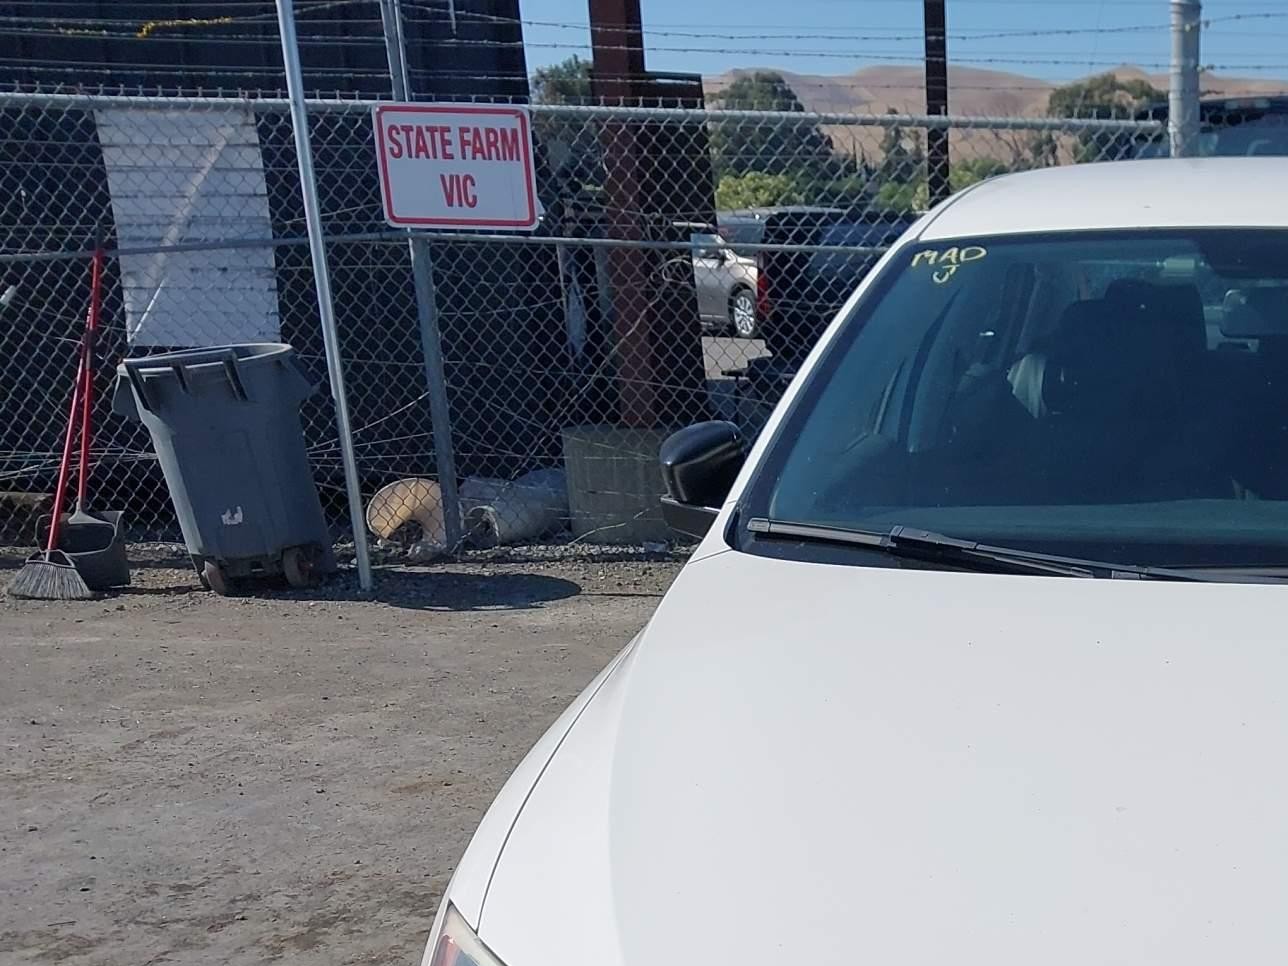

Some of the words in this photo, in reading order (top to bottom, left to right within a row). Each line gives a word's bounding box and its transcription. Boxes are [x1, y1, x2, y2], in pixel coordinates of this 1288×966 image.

[387, 124, 455, 160] STATE
[458, 126, 521, 162] FARM
[439, 173, 478, 208] VIC
